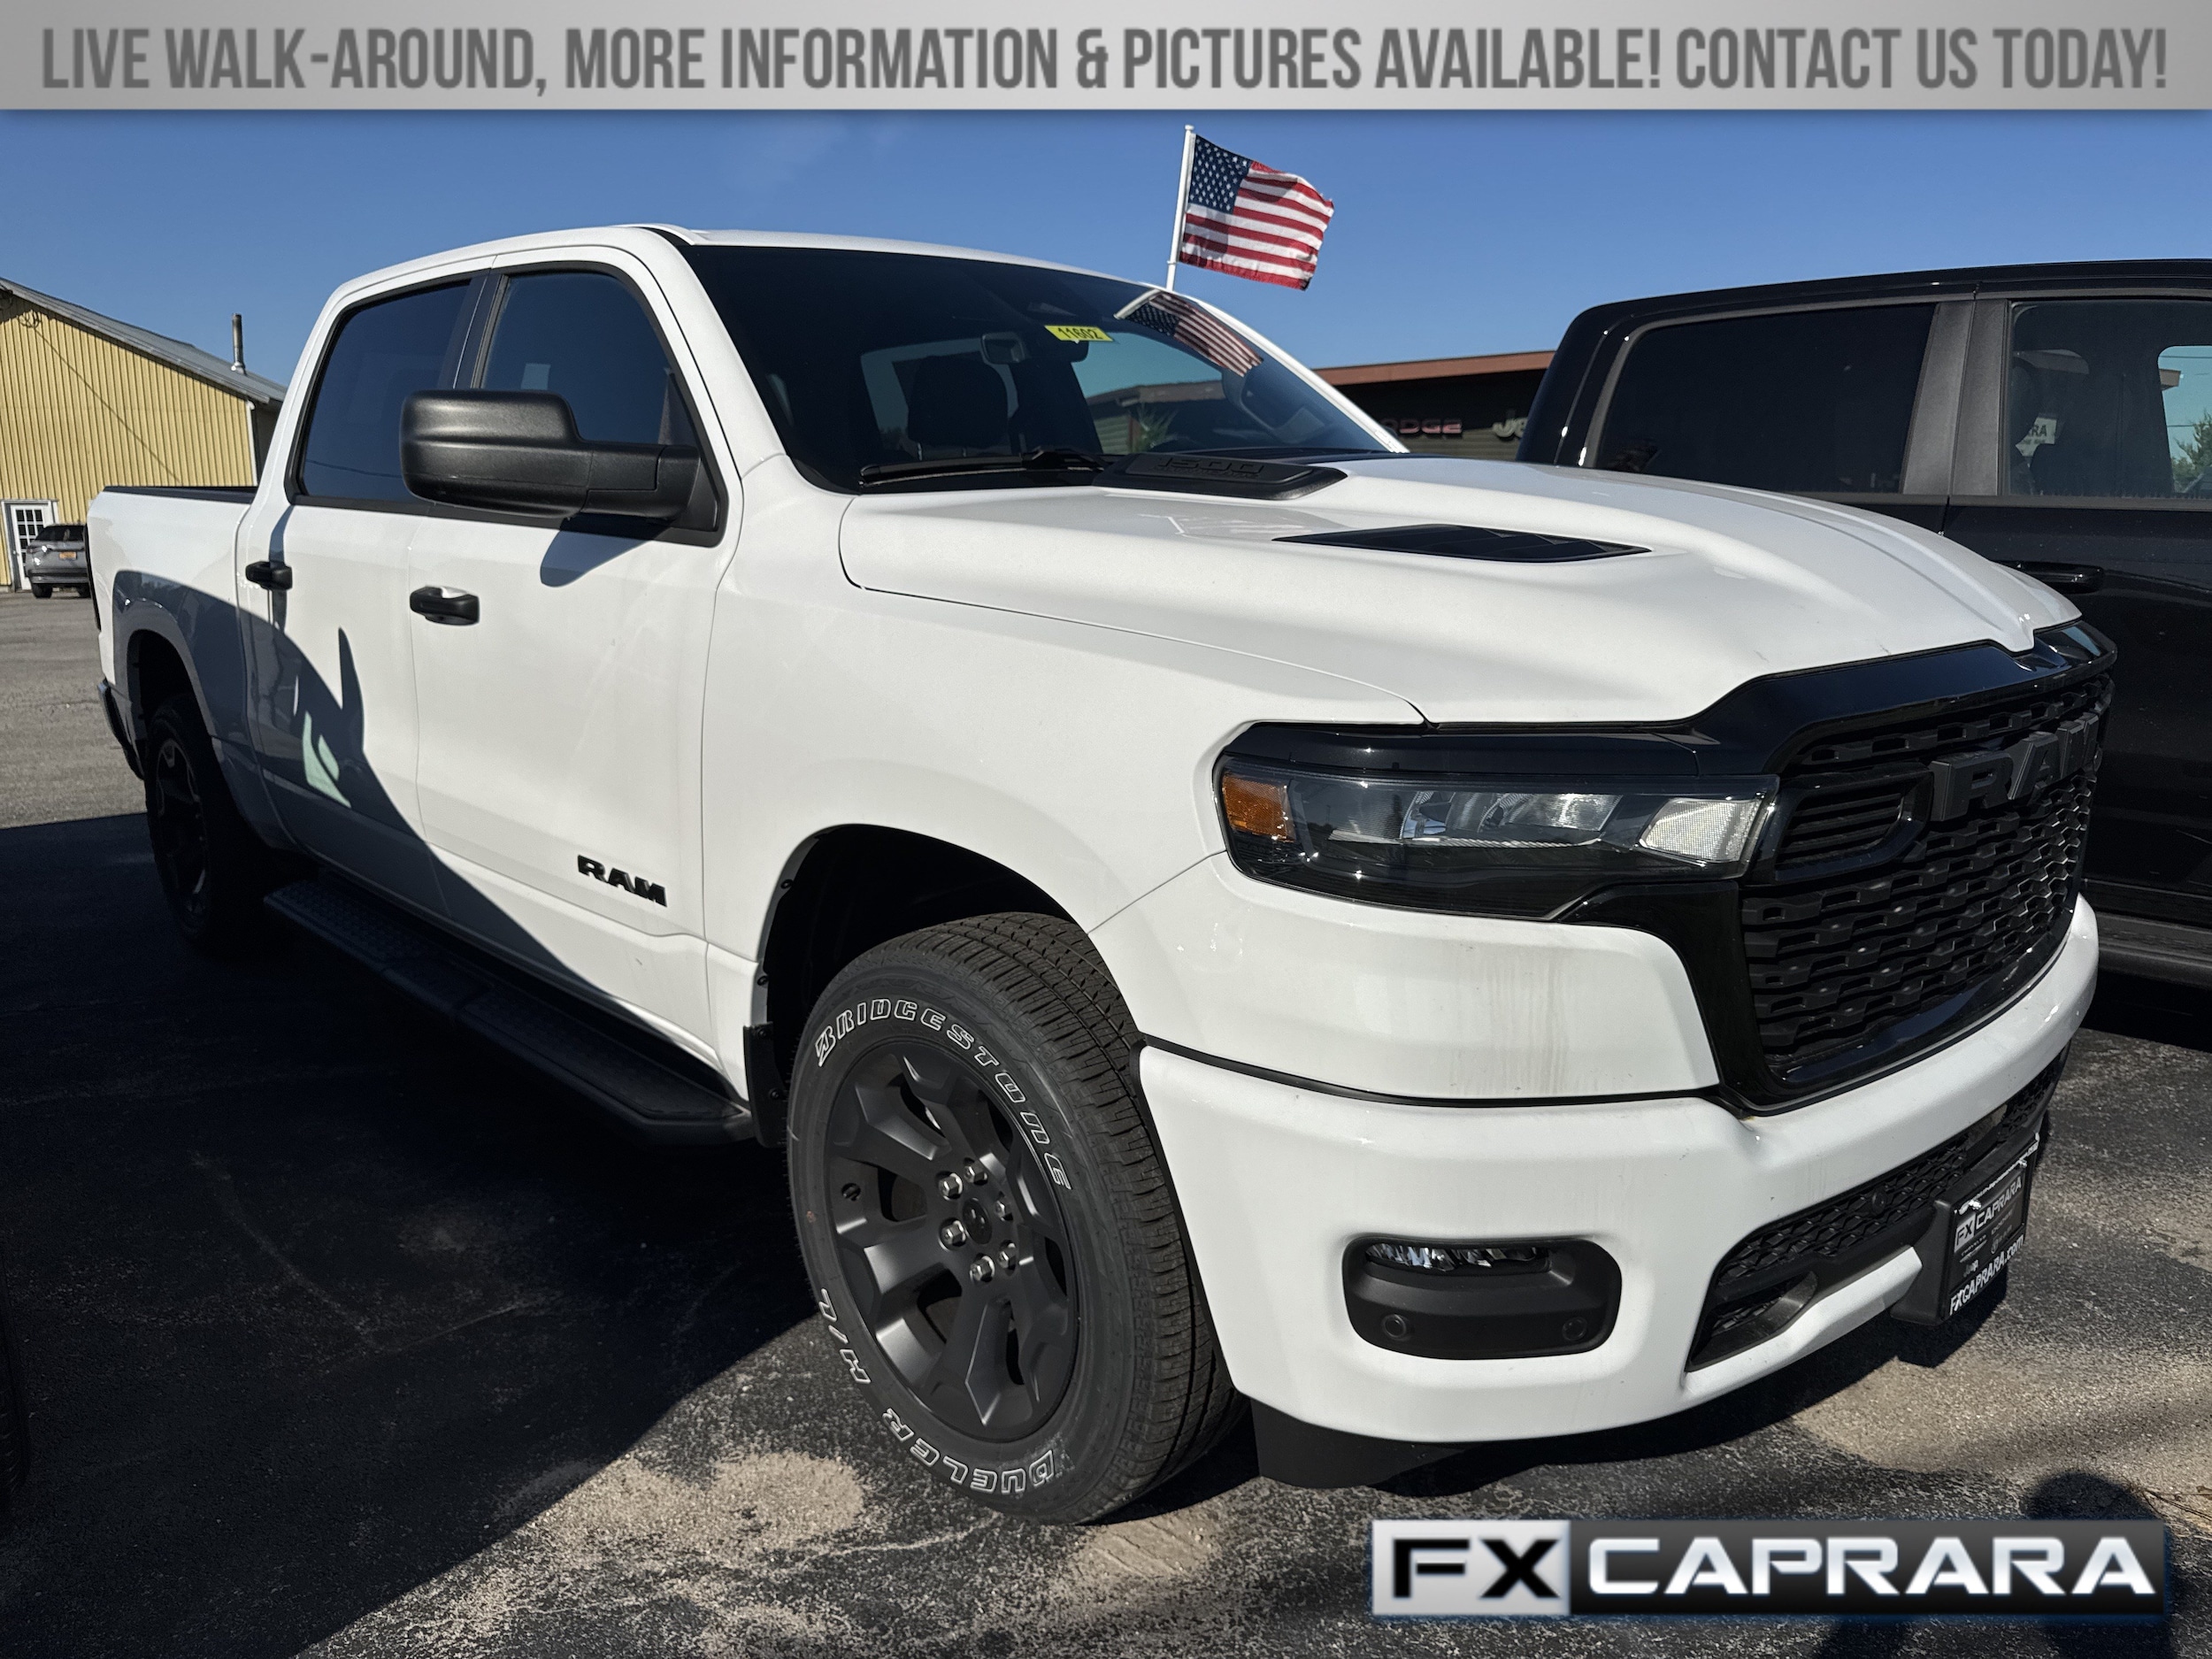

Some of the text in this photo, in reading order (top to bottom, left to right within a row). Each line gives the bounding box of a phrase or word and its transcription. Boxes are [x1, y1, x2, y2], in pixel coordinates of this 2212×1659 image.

[1057, 326, 1104, 341] 11602
[1929, 712, 2100, 822] RAM
[577, 854, 668, 908] RAM
[814, 998, 1071, 1190] BRIDGESTONE
[1955, 1218, 1975, 1247] FX
[1975, 1175, 2023, 1231] CAPRARA
[818, 1287, 1056, 1495] DUELER H/L
